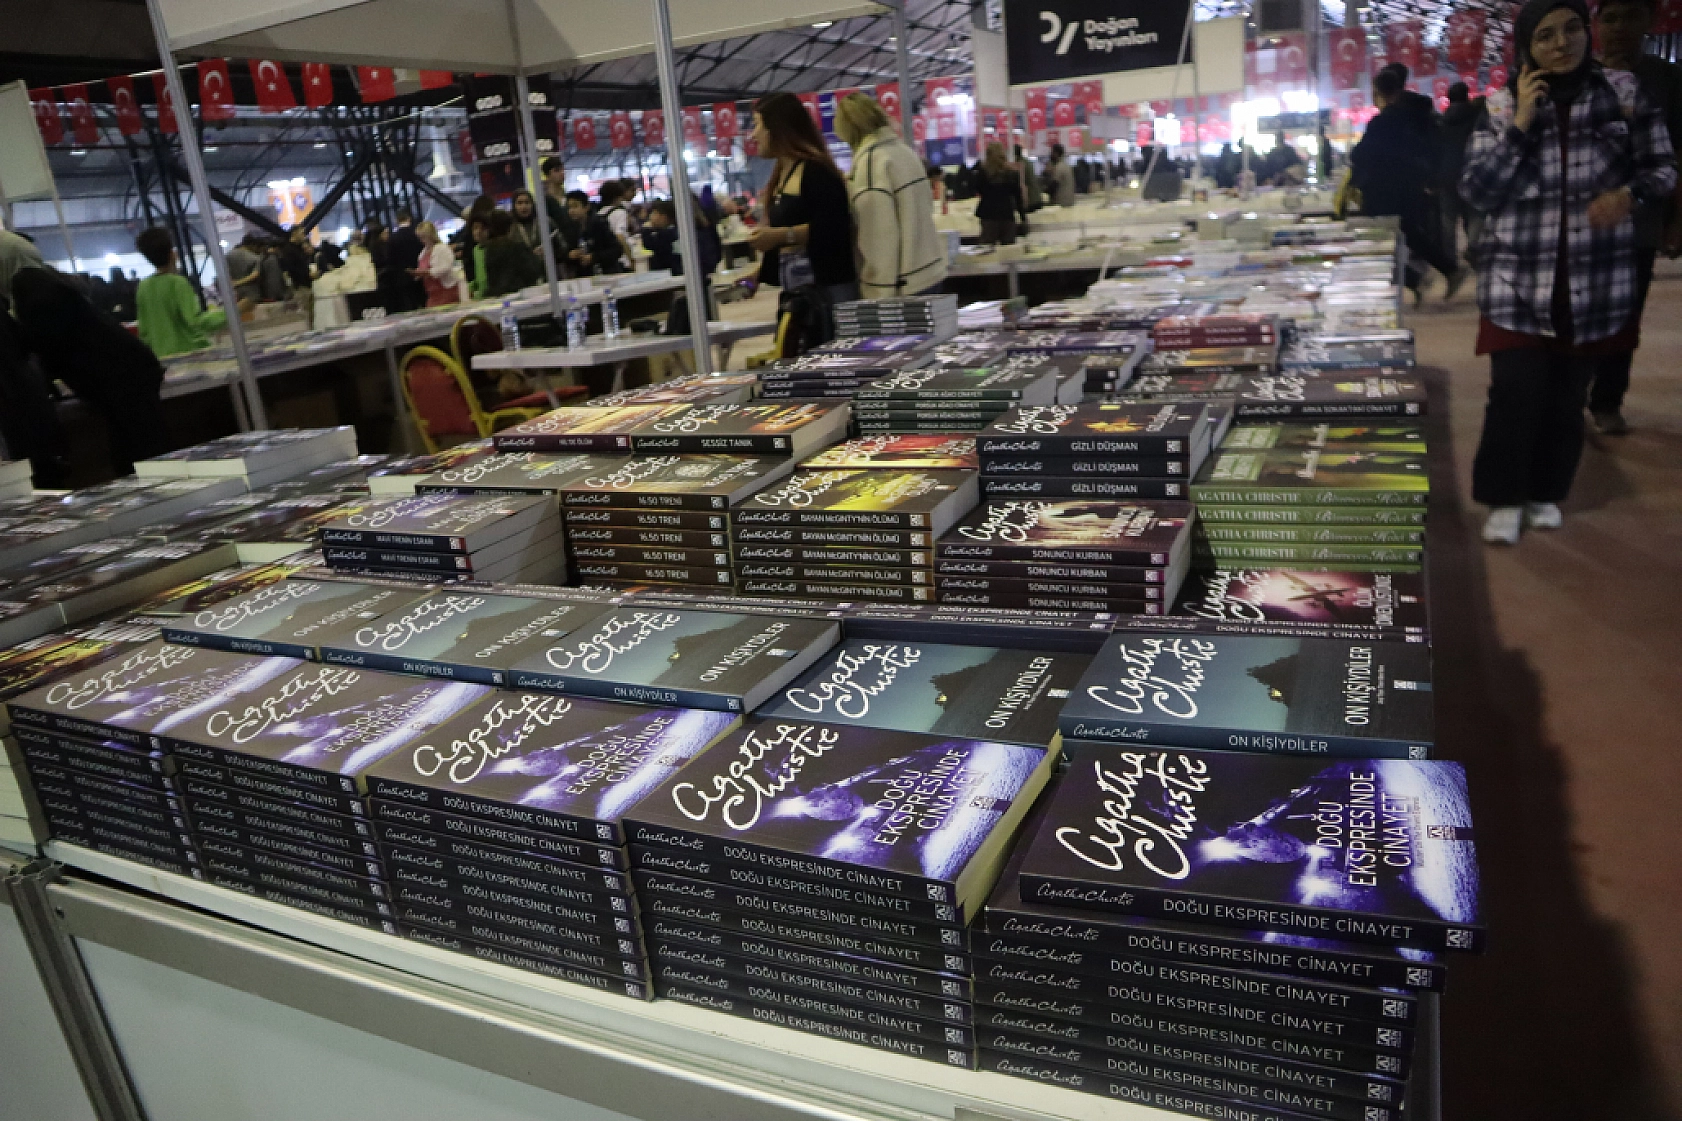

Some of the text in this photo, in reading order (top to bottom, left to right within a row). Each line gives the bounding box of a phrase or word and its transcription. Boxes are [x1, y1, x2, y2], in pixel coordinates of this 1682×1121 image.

[1071, 441, 1139, 452] GİZLİ DÜŞMAN
[1072, 461, 1139, 473] GİZLİ DÜŞMAN
[1072, 483, 1138, 494] GİZLİ DÜŞMAN
[1244, 492, 1301, 502] CHRISTIE
[1244, 511, 1299, 521] CHRISTIE
[1027, 566, 1107, 579] SONUNCU KURBAN
[1033, 550, 1112, 561] SONUNCU KURBAN
[1028, 583, 1107, 595] SONUNCU KURBAN
[1029, 598, 1107, 611] SONUNCU KURBAN
[355, 596, 462, 647] Agatha
[382, 597, 486, 650] Christie
[546, 611, 650, 668] Agatha
[582, 612, 681, 673] Christie
[614, 687, 678, 702] ON KİŞİYDİLER
[786, 645, 882, 713] Agatha
[835, 645, 921, 718] Christie
[985, 656, 1054, 728] ON KİŞİYDİLER
[1087, 637, 1165, 714] Agatha
[1153, 638, 1219, 719] Christie
[1343, 646, 1373, 725] ON KİŞİYDİLER
[206, 668, 334, 737] Agatha
[232, 669, 360, 743] Christie
[413, 694, 538, 776] Agatha
[449, 696, 572, 784] Christie
[1228, 735, 1328, 753] ON KİŞİYDİLER
[672, 723, 798, 821] Agatha
[722, 724, 839, 830] Christie
[875, 769, 923, 812] DOĞU
[874, 748, 970, 846] EKSPRESİNDE
[916, 769, 970, 830] CİNAYET
[1055, 752, 1148, 871] Agatha
[1134, 752, 1212, 881] Christie
[1311, 801, 1343, 848] DOĞU
[1345, 772, 1377, 887] EKSPRESİNDE
[1378, 792, 1411, 867] CİNAYET
[724, 846, 901, 890] DOĞU EKSPRESİNDE CİNAYET
[730, 869, 910, 910] DOĞU EKSPRESİNDE CİNAYET
[736, 895, 915, 935] DOĞU EKSPRESİNDE CİNAYET
[1164, 899, 1208, 915] DOĞU
[1215, 905, 1329, 928] EKSPRESİNDE
[1336, 918, 1412, 938] CİNAYET
[741, 918, 919, 961] DOĞU EKSPRESİNDE CİNAYET
[741, 942, 917, 985] DOĞU EKSPRESİNDE CİNAYET
[1128, 935, 1373, 976] DOĞU EKSPRESİNDE CİNAYET
[746, 964, 919, 1010] DOĞU EKSPRESİNDE CİNAYET
[1111, 959, 1350, 1007] DOĞU EKSPRESİNDE CİNAYET
[748, 986, 922, 1032] DOĞU EKSPRESİNDE CİNAYET
[753, 1008, 924, 1054] DOĞU EKSPRESİNDE CİNAYET
[1108, 986, 1344, 1034] DOĞU EKSPRESİNDE CİNAYET
[1111, 1012, 1342, 1061] DOĞU EKSPRESİNDE CİNAYET
[1107, 1036, 1335, 1088] DOĞU EKSPRESİNDE CİNAYET
[1108, 1058, 1332, 1111] DOĞU EKSPRESİNDE CİNAYET
[1110, 1083, 1151, 1102] DOĞU
